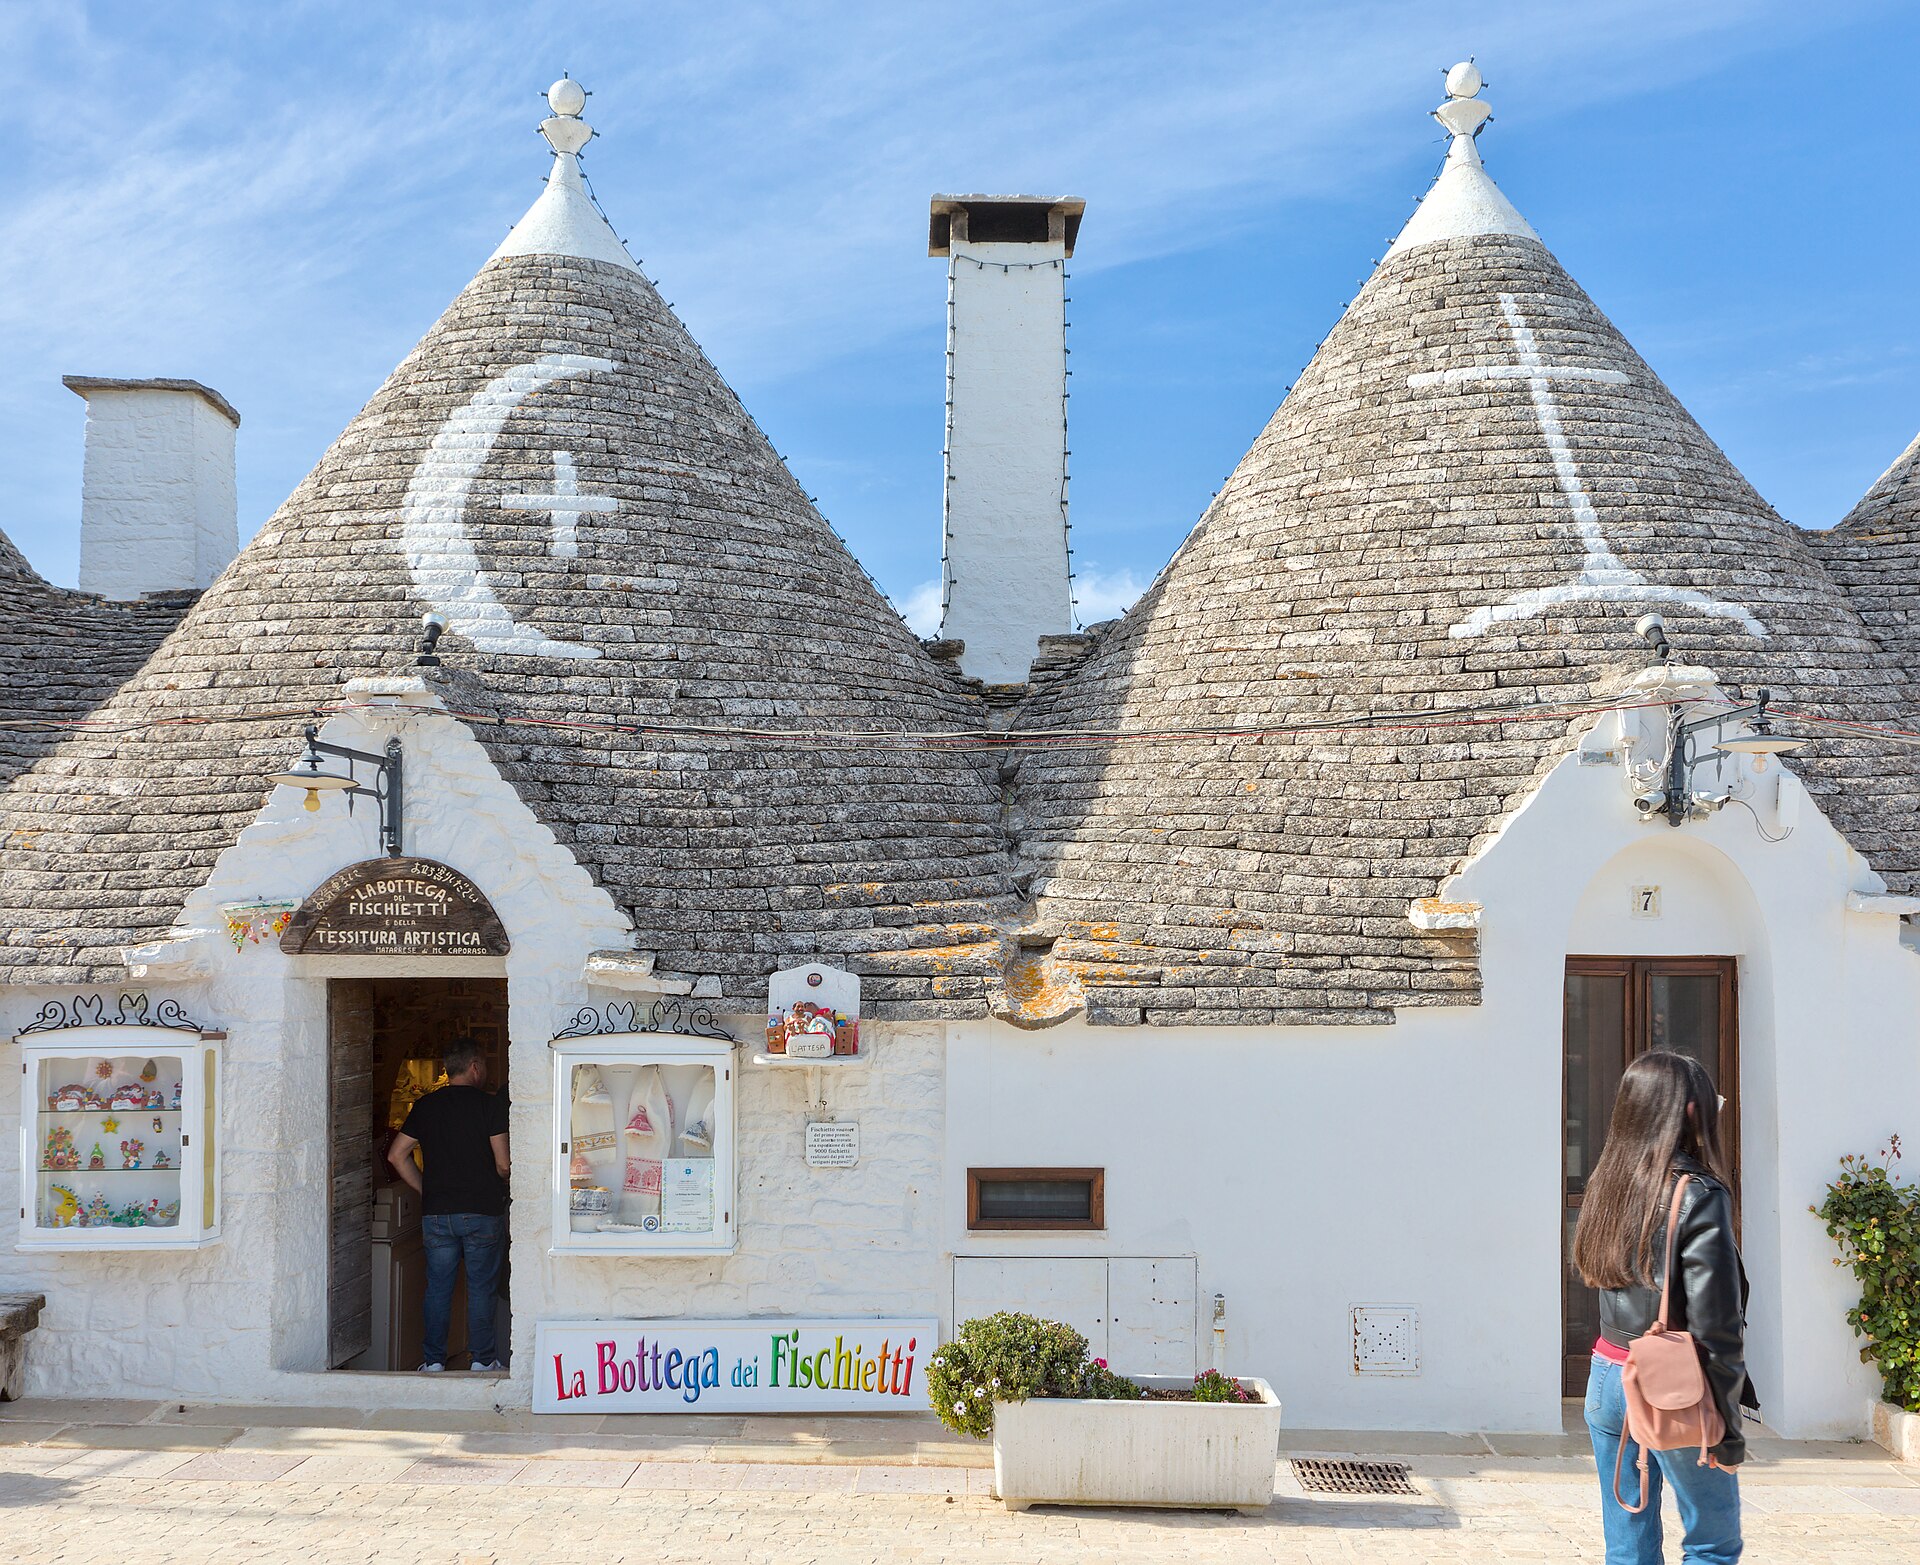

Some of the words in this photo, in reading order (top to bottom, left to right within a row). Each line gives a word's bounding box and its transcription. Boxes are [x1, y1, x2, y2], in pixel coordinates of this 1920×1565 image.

[1642, 891, 1653, 911] 7
[349, 902, 447, 916] FISCHIETTI
[316, 930, 397, 945] TESSITURA
[403, 931, 481, 946] ARTISTICA
[375, 946, 417, 954] MATARRESE
[791, 1044, 826, 1053] L'ATTESA
[553, 1353, 587, 1400] La
[595, 1335, 721, 1403] Bottega
[730, 1355, 758, 1388] dei
[768, 1328, 917, 1397] Fischietti
